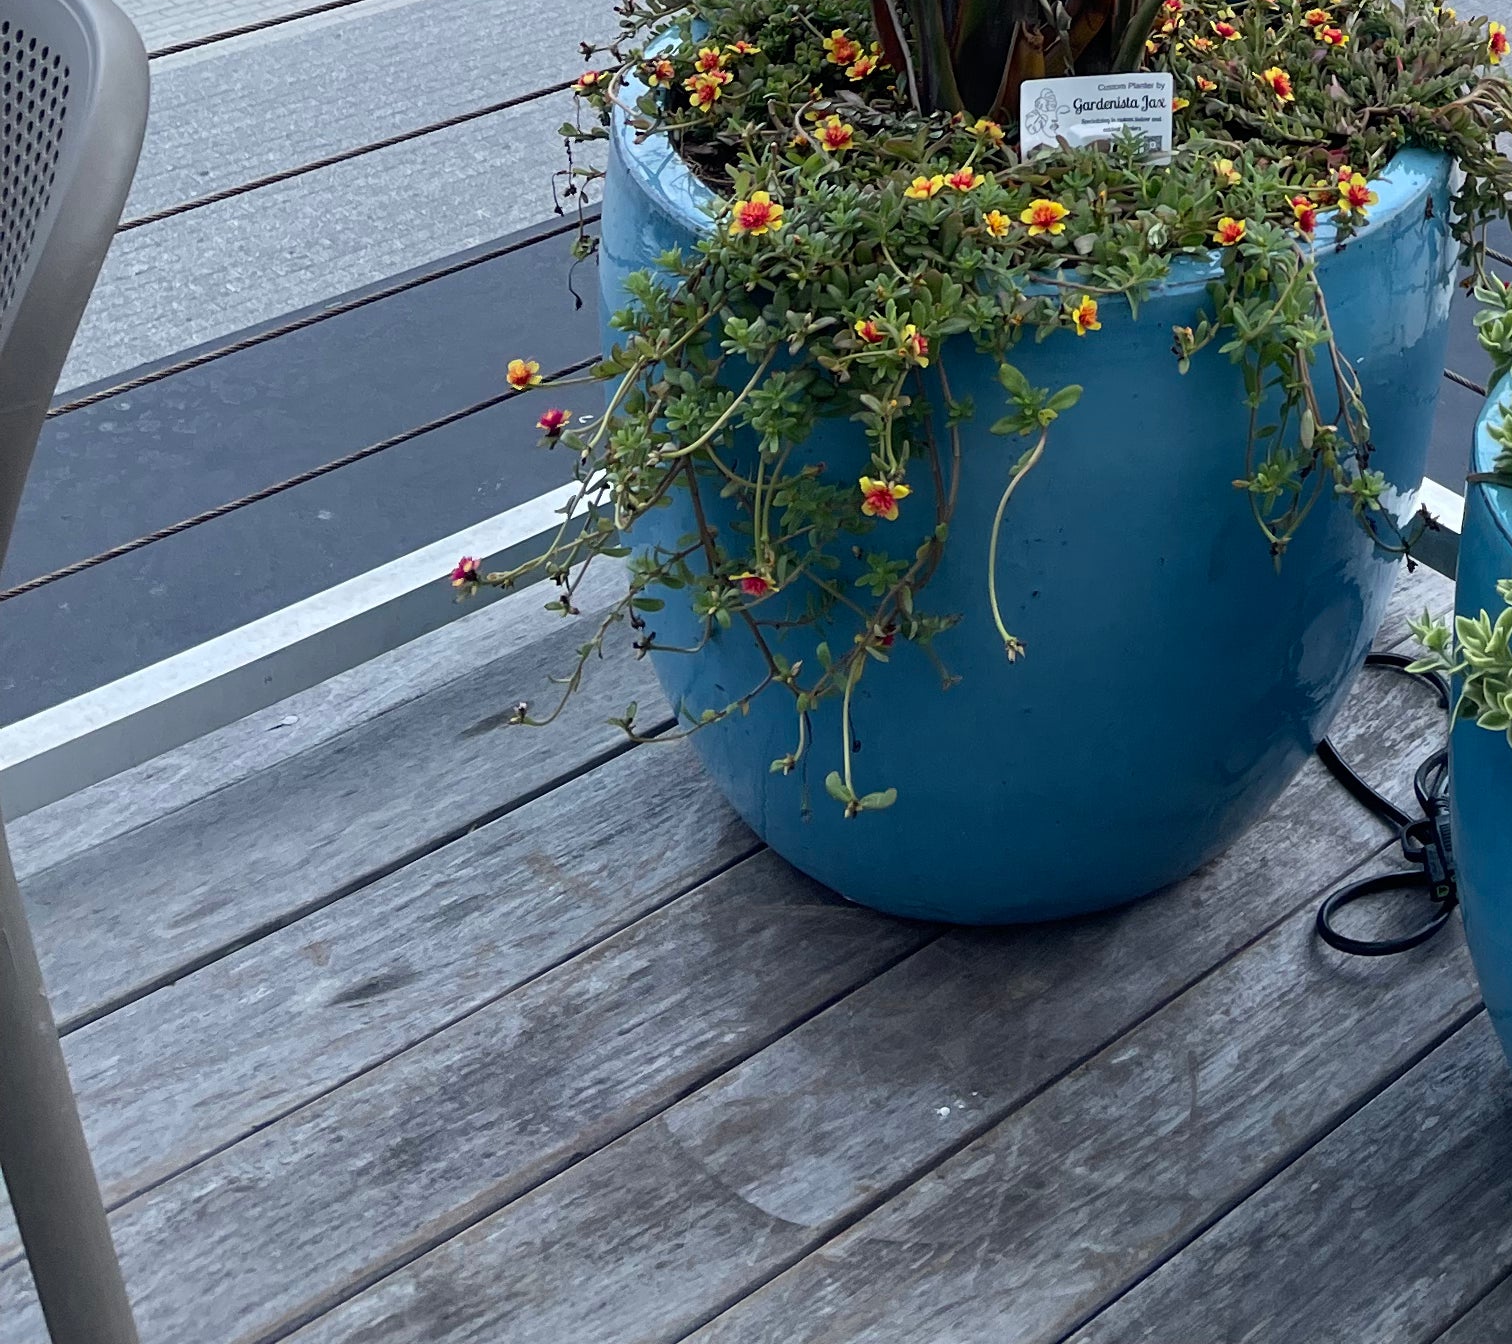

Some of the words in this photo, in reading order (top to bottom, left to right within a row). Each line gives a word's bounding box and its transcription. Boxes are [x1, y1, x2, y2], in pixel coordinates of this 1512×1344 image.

[1156, 82, 1165, 90] by
[1073, 97, 1139, 114] Gardenista
[1141, 95, 1167, 111] Jax
